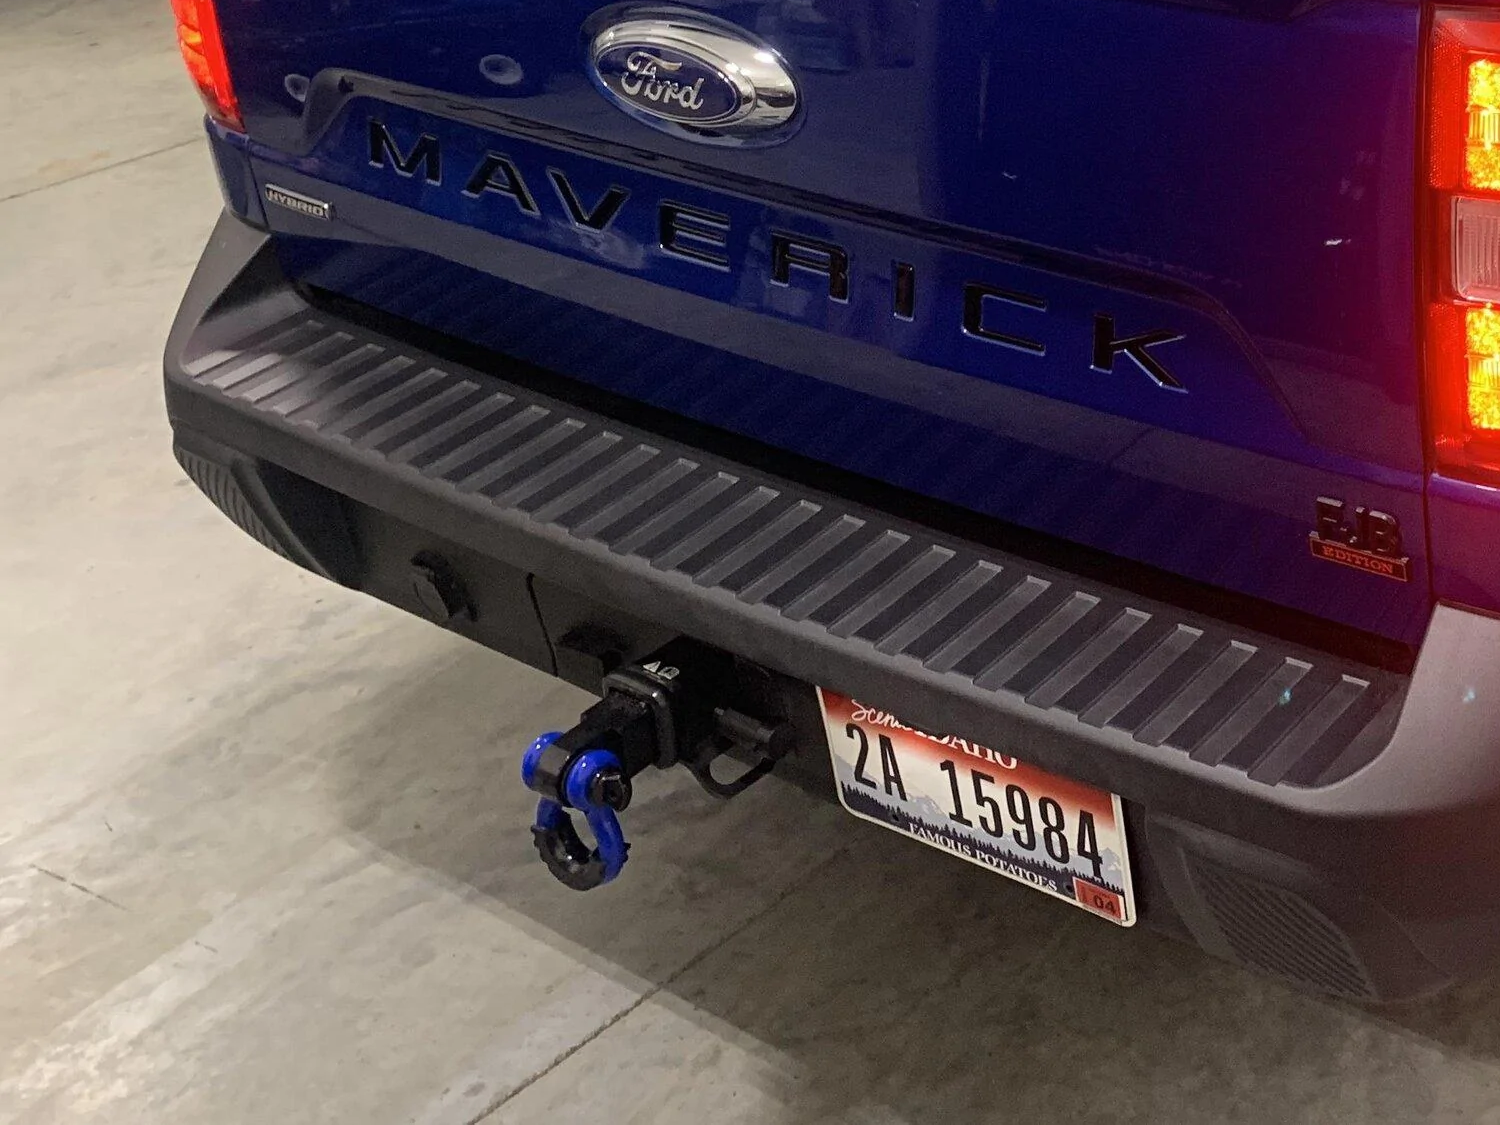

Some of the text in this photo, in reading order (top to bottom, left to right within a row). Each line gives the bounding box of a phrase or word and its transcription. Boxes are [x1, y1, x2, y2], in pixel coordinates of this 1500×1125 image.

[620, 51, 705, 111] Ford
[268, 190, 324, 216] HYBRID
[365, 118, 1190, 394] MAVERICK
[1321, 545, 1394, 573] EDITION
[845, 722, 1104, 877] 2A 15984
[909, 822, 1058, 893] FAMOUS POTATOES
